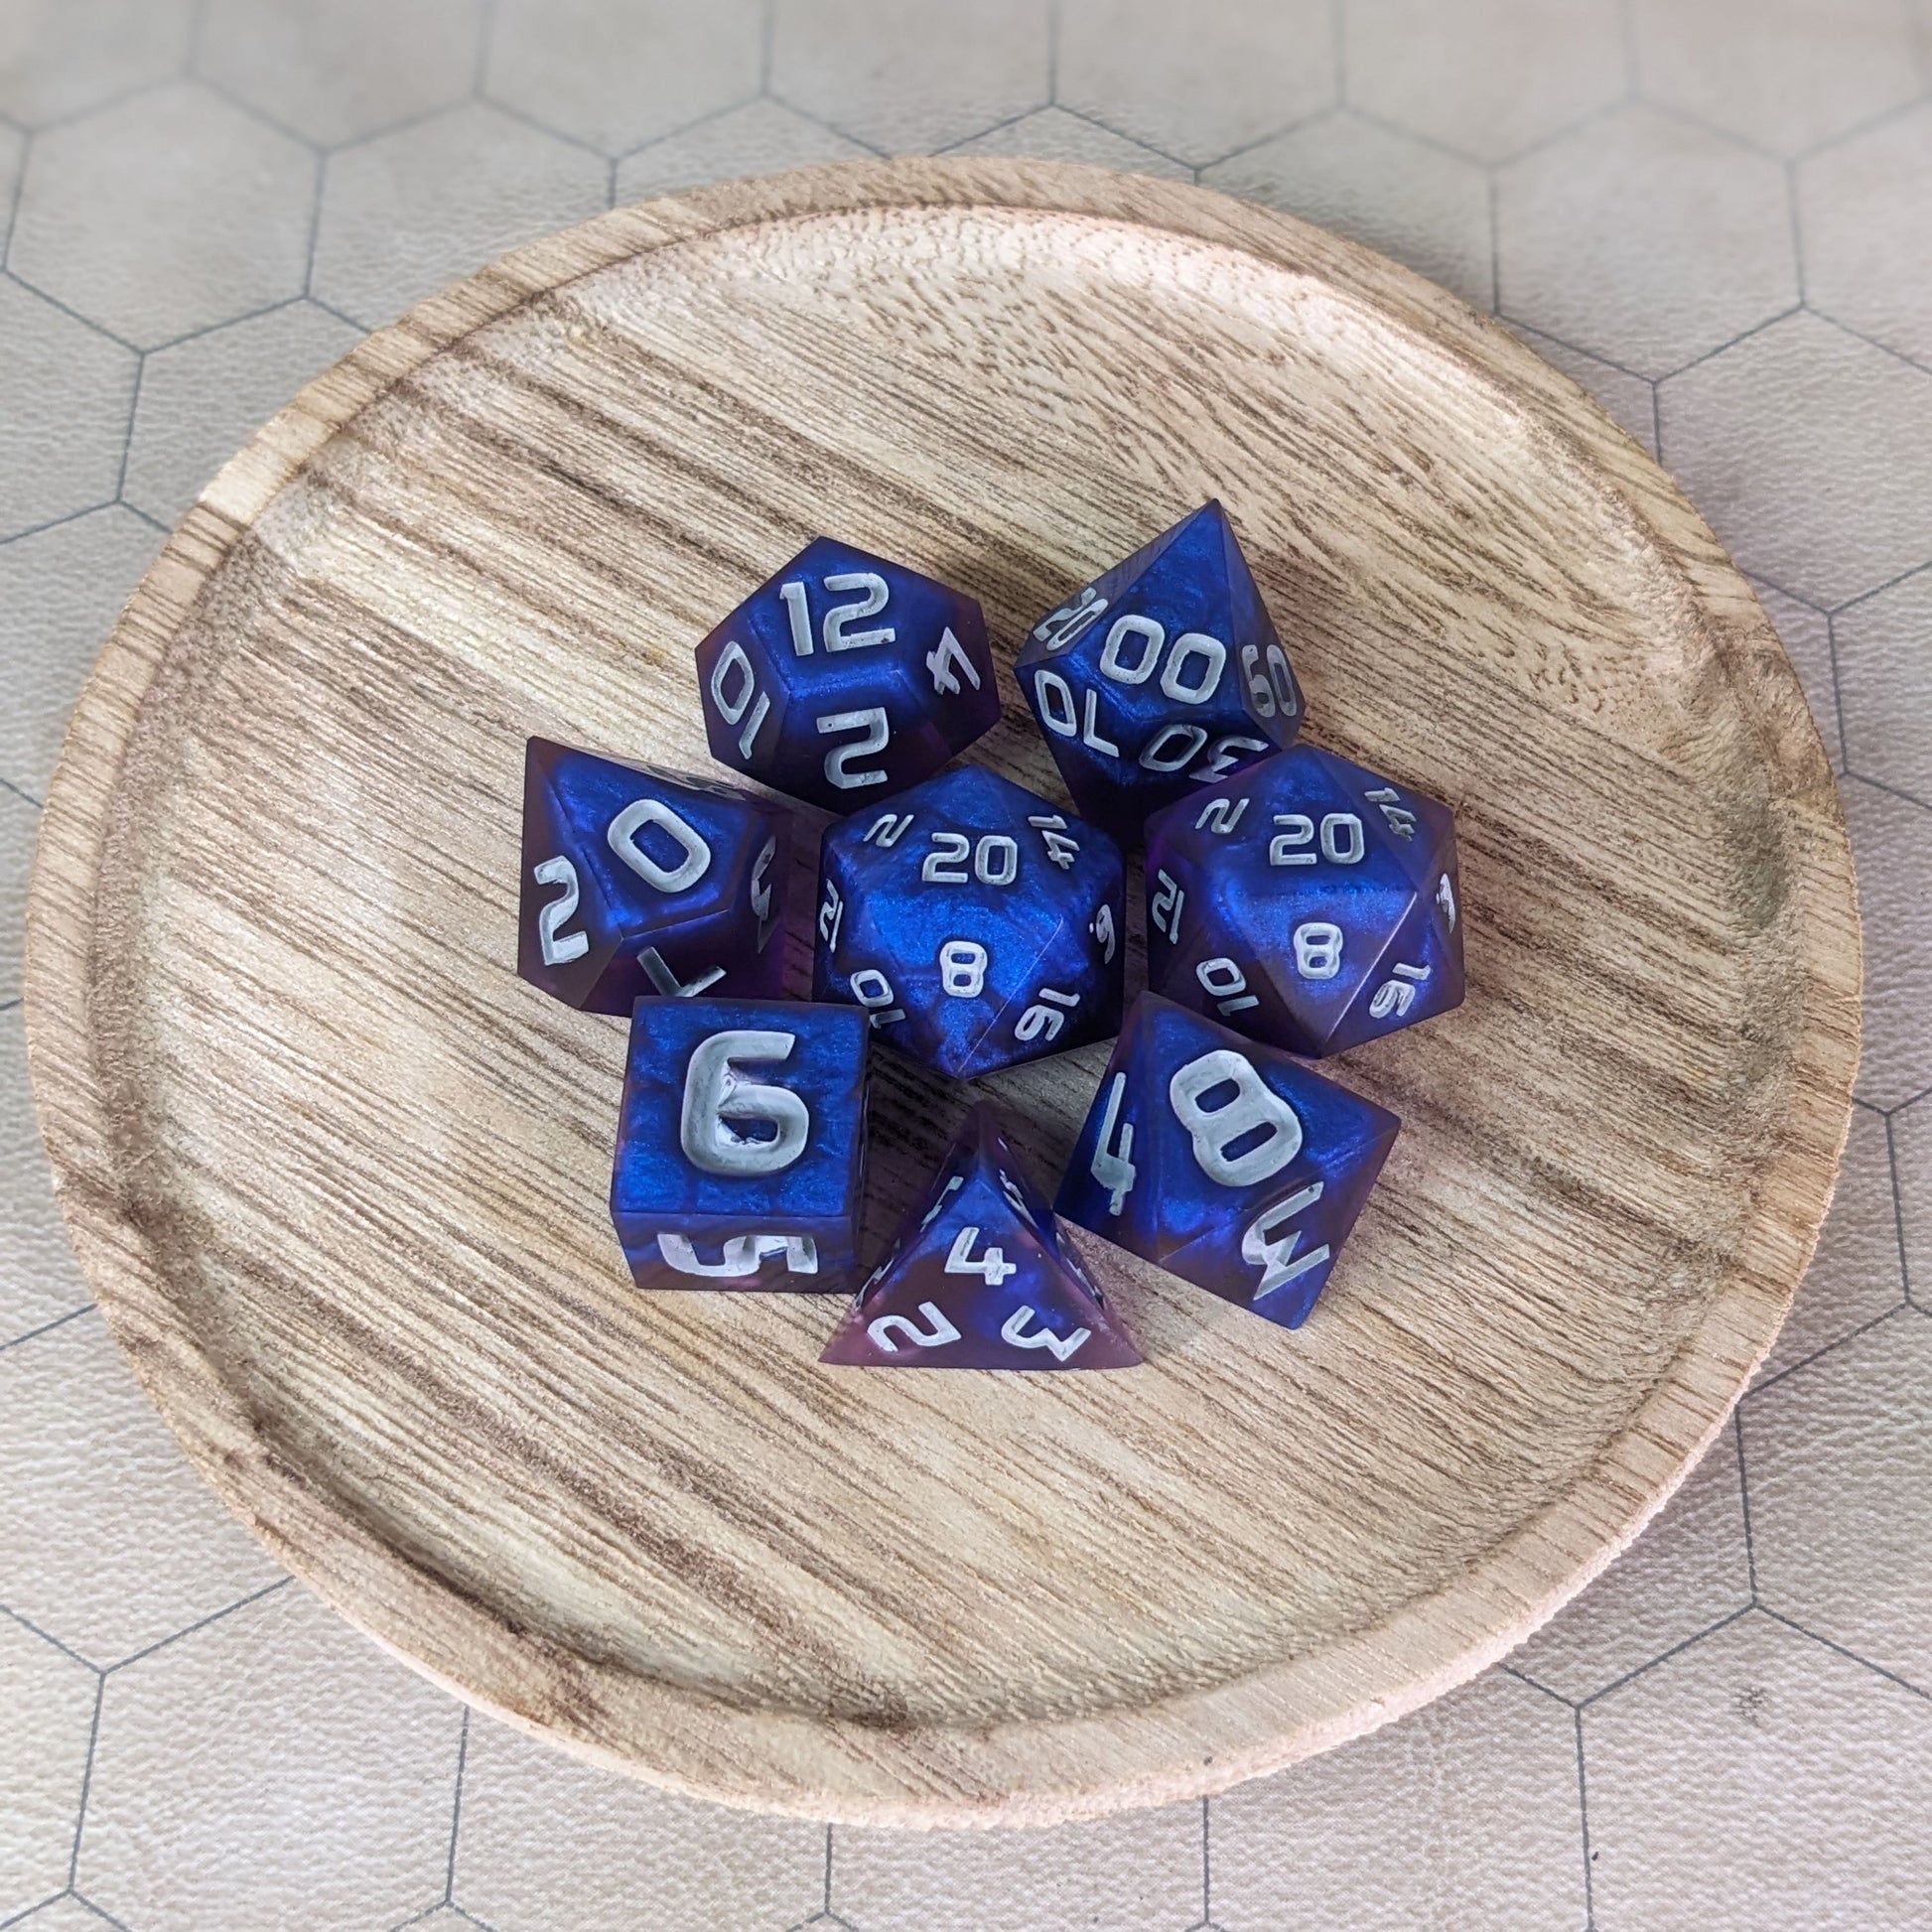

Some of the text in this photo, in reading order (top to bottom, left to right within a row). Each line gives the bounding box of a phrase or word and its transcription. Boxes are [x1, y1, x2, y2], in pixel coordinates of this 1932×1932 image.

[779, 572, 896, 656] 12
[1033, 587, 1109, 650] 20
[925, 626, 981, 695] 4
[1099, 615, 1226, 705] 00
[1241, 644, 1298, 718] 60
[711, 640, 770, 759] 10
[1035, 669, 1119, 758] 70
[816, 707, 890, 789] 2
[1139, 724, 1269, 784] 30
[863, 813, 915, 848] 2
[1028, 813, 1080, 870] 14
[1194, 797, 1250, 834] 2
[1269, 813, 1365, 866] 20
[1364, 787, 1417, 842] 14
[607, 798, 712, 894] 0
[921, 832, 1018, 886] 20
[533, 855, 590, 966] 2
[1152, 868, 1184, 944] 12
[939, 940, 988, 999] 8
[1293, 921, 1343, 980] 8
[850, 969, 906, 1029] 10
[1014, 988, 1081, 1041] 16
[1195, 957, 1260, 1017] 10
[1369, 962, 1432, 1019] 16
[680, 1030, 809, 1176] 6
[1170, 1049, 1303, 1187] 8
[1090, 1071, 1136, 1216] 4
[657, 1233, 818, 1278] 5
[944, 1226, 1017, 1286] 4
[867, 1301, 962, 1352] 2
[1001, 1305, 1091, 1361] 3
